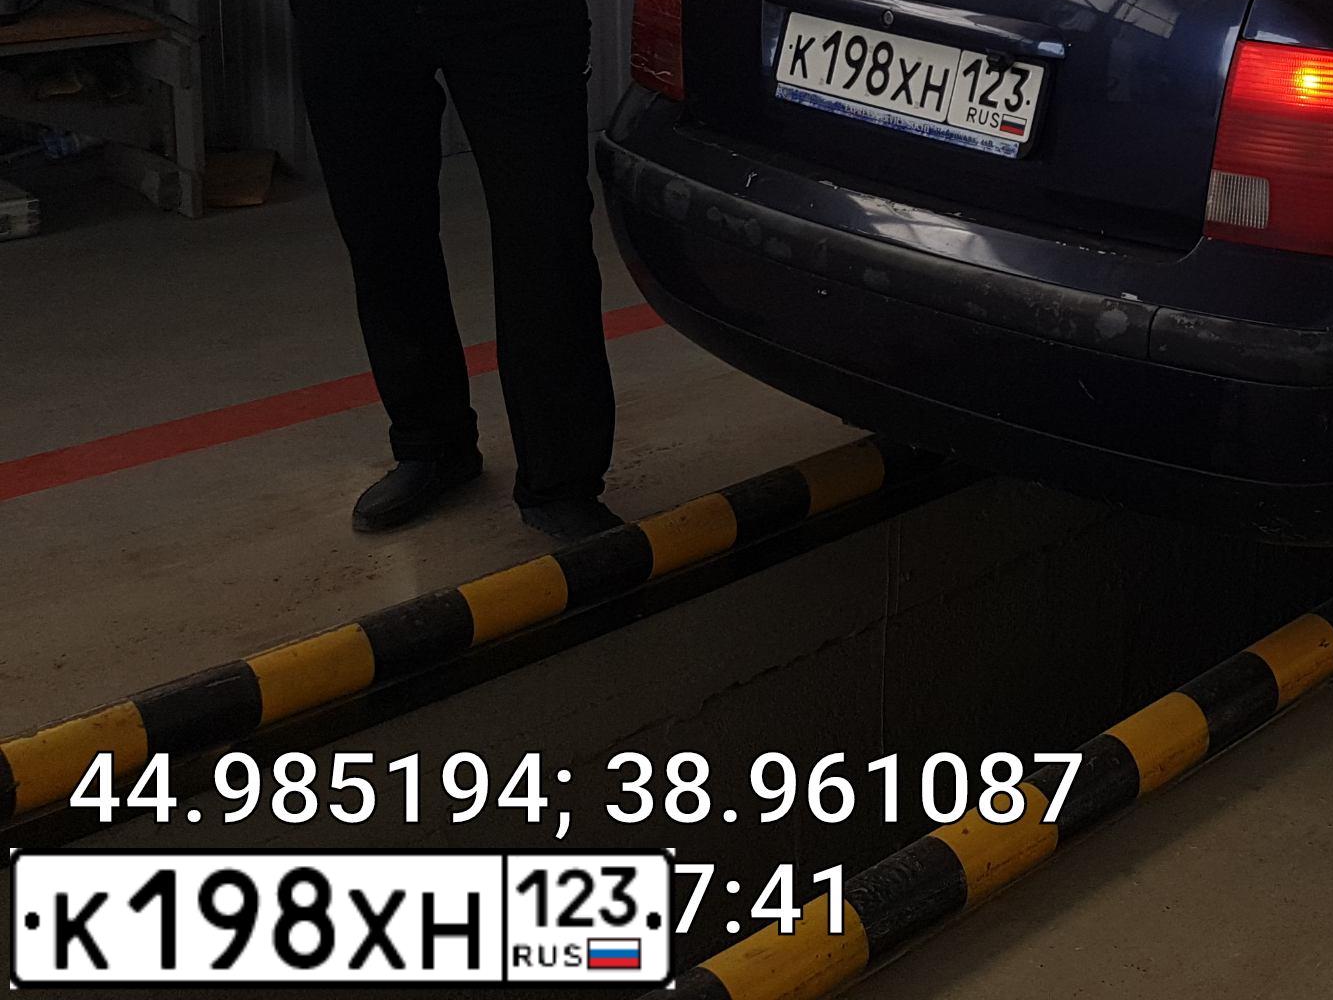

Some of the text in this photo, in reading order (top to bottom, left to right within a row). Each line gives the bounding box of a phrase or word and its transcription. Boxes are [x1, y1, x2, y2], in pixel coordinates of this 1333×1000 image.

[789, 30, 950, 113] К198ХН
[962, 58, 1031, 113] 123
[966, 106, 1000, 129] RUS
